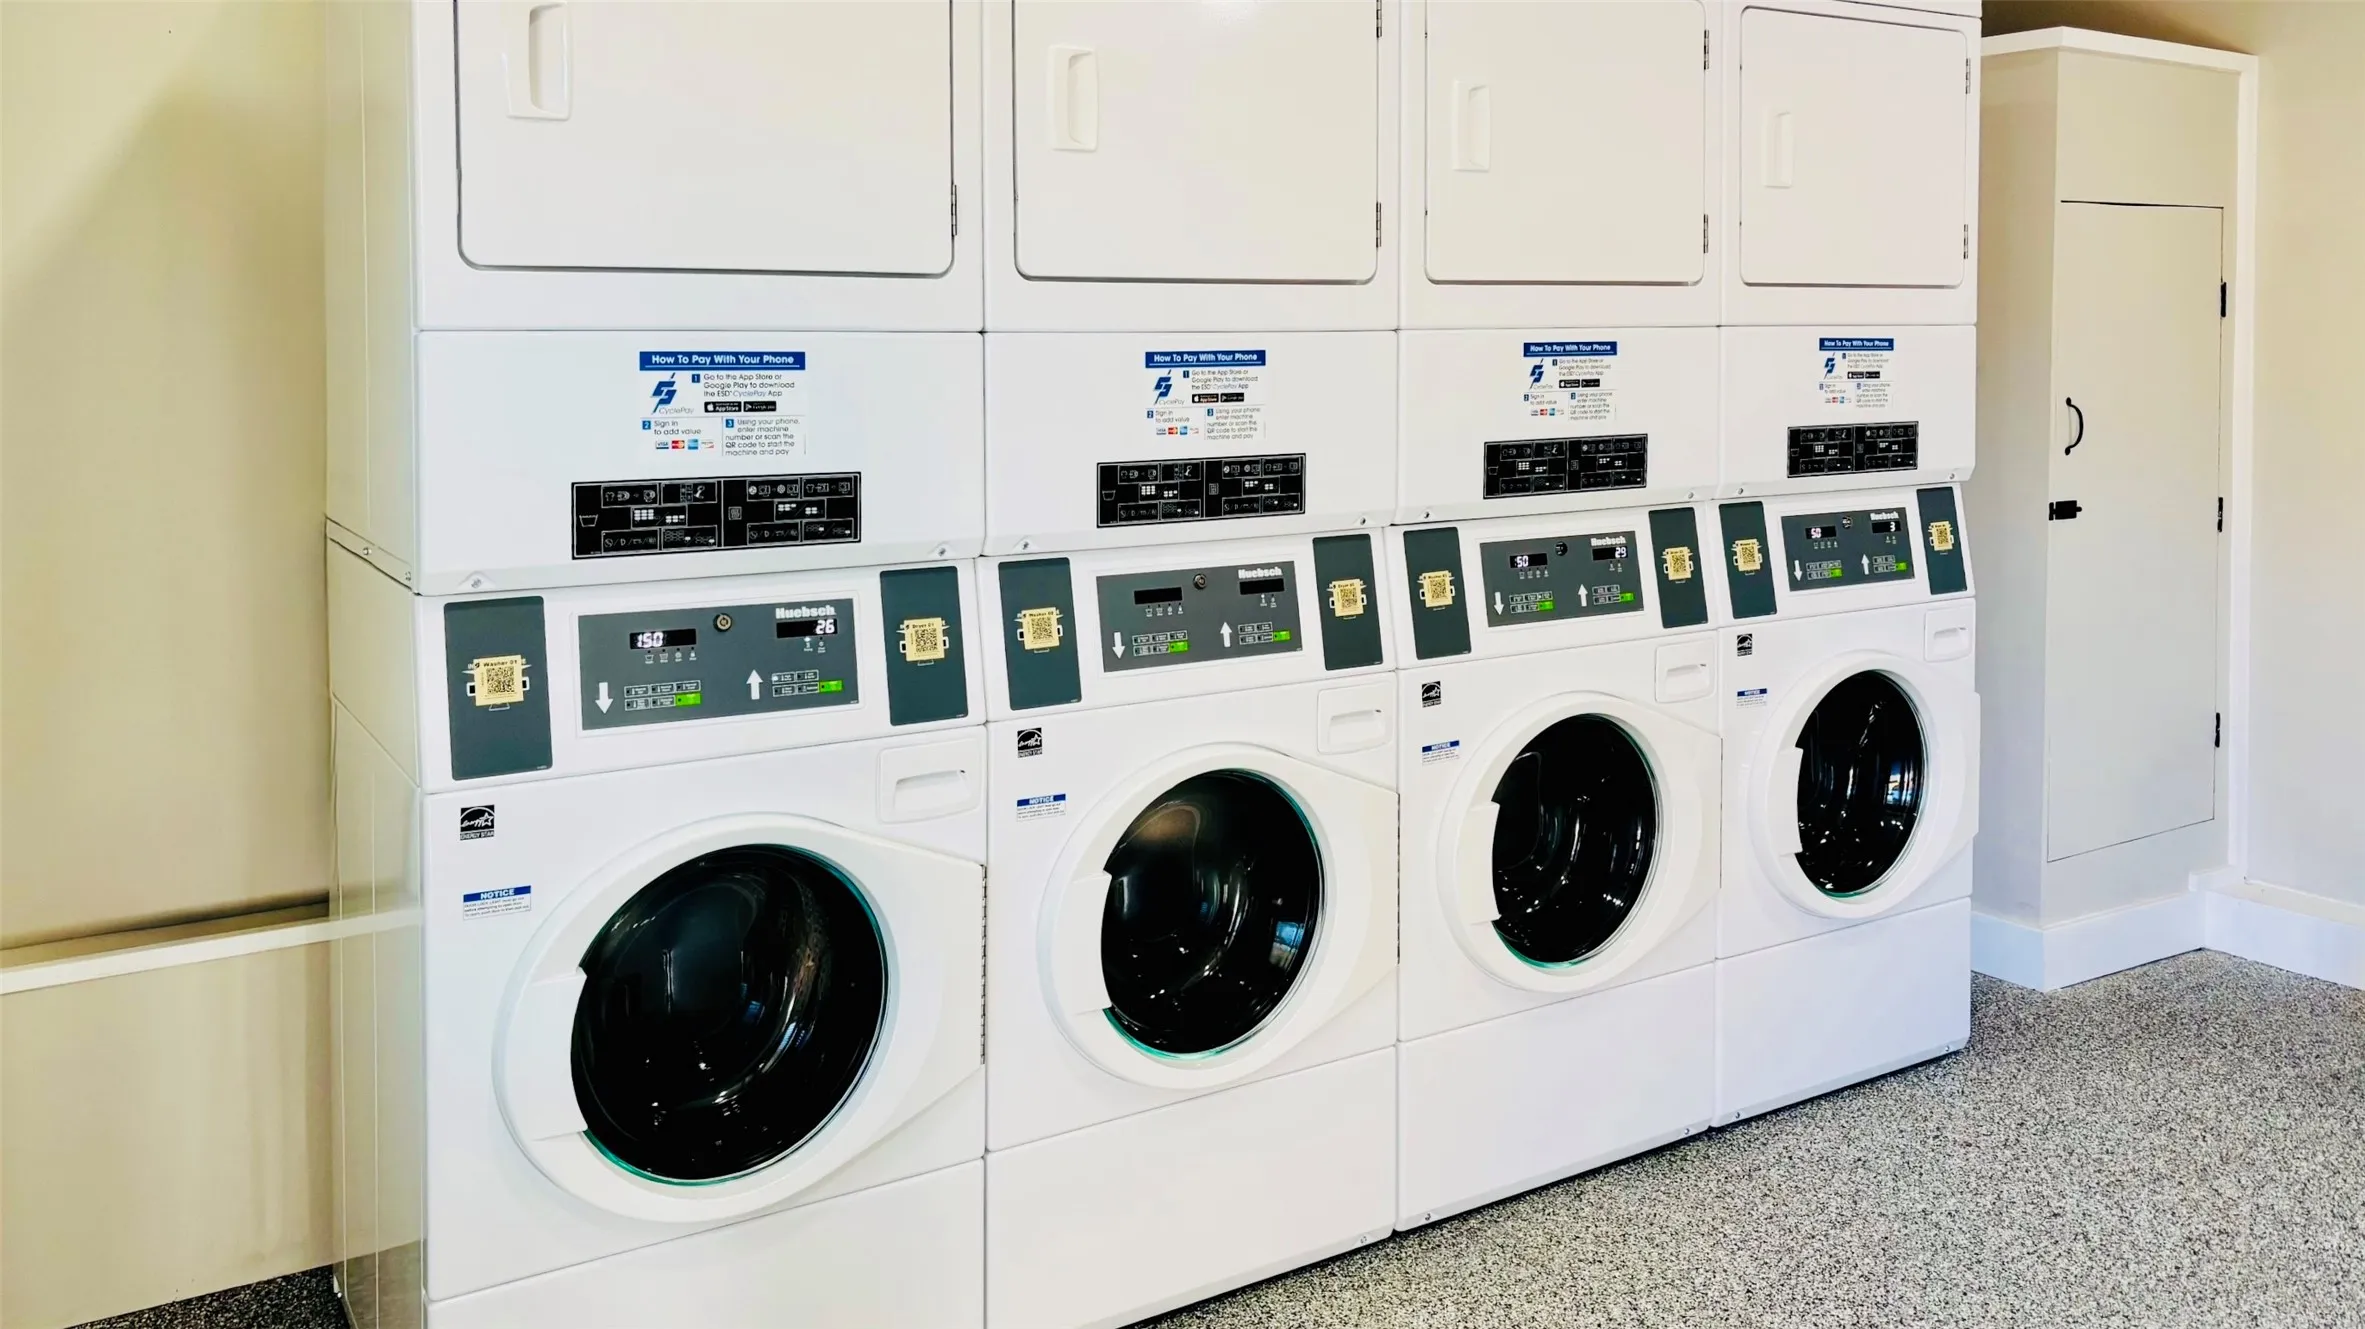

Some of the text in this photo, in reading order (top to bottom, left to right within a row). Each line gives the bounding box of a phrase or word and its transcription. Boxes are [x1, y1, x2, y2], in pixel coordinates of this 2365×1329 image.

[1544, 344, 1552, 352] To
[1552, 344, 1564, 353] Pay
[1565, 344, 1578, 352] With
[1842, 340, 1852, 348] Pay
[651, 354, 794, 365] How To Pay With Your Phone
[1154, 353, 1258, 363] How To Pay With Your Phone
[739, 373, 754, 382] App
[768, 390, 783, 398] App
[654, 420, 670, 428] Sign
[1889, 521, 1896, 532] 3
[1614, 546, 1627, 558] 29
[1238, 566, 1283, 579] Huebsch
[775, 604, 837, 619] Huebsch
[815, 618, 835, 635] 26
[1029, 795, 1054, 805] NOTICE
[480, 888, 515, 900] NOTICE
